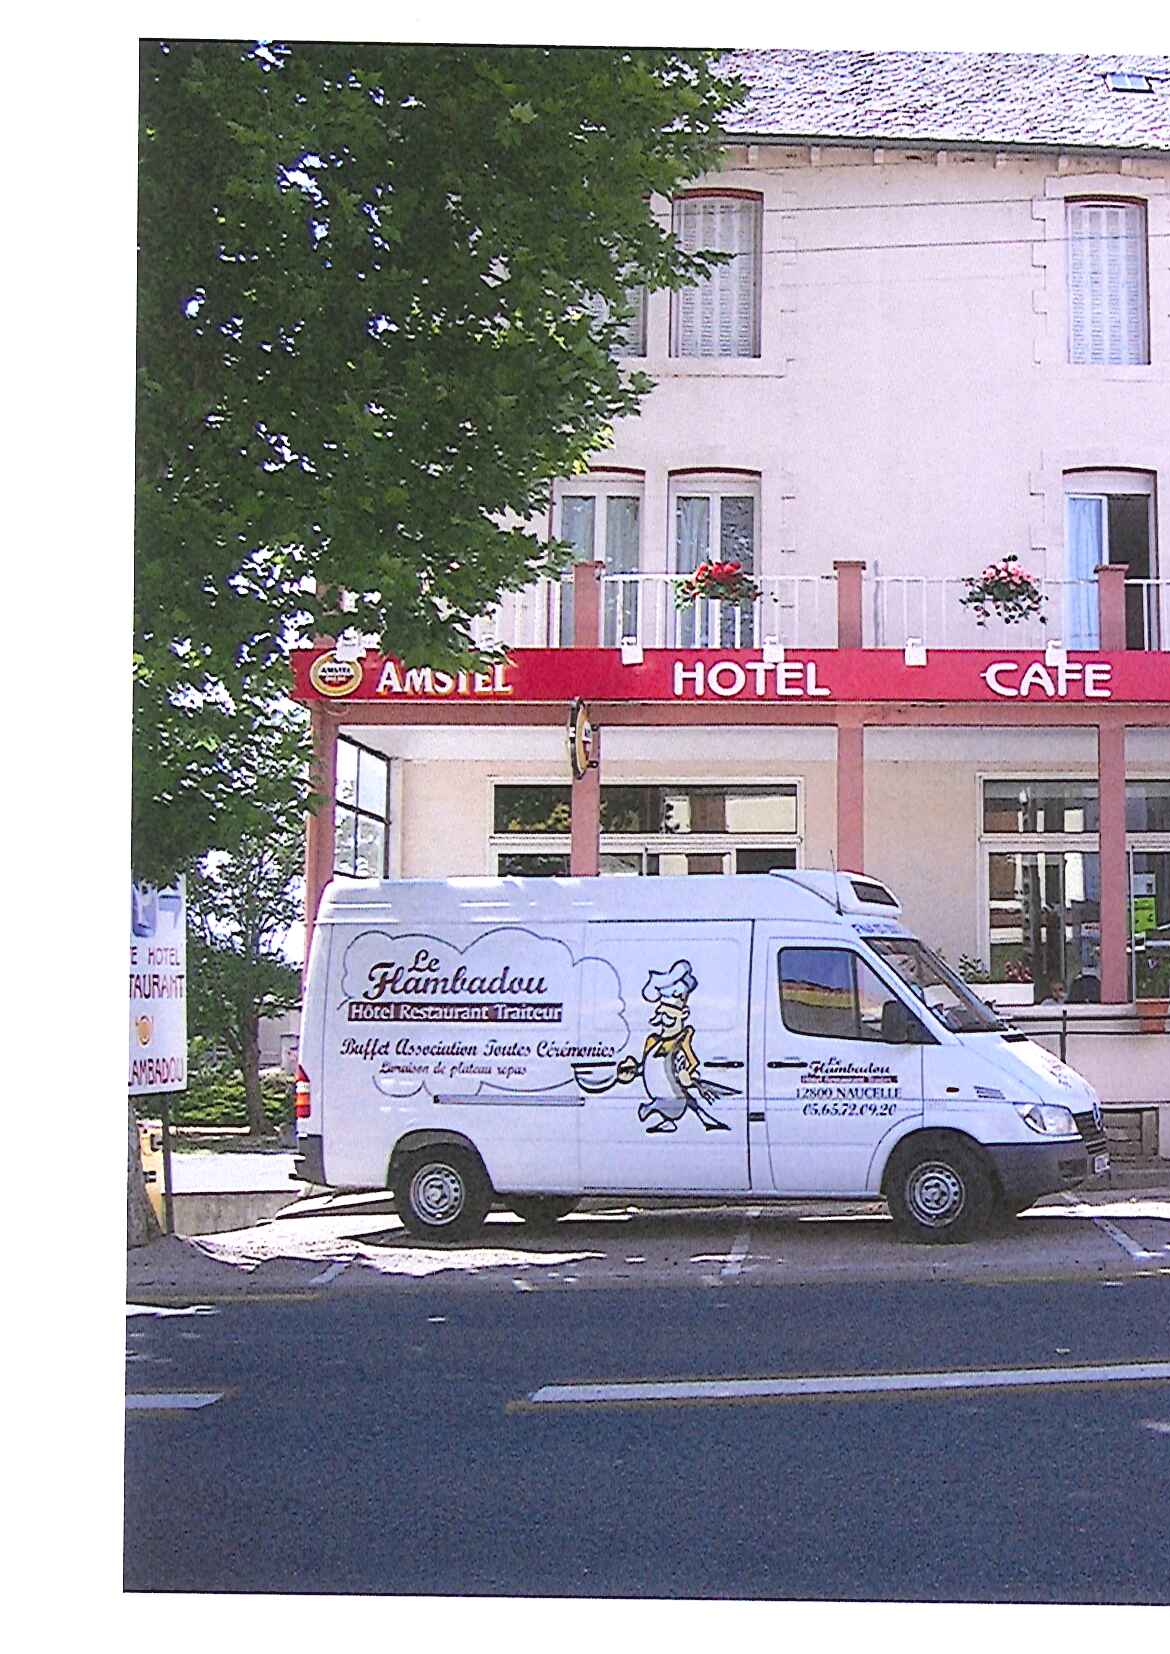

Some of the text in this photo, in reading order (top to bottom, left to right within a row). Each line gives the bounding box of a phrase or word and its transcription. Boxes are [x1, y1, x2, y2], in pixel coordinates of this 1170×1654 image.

[673, 660, 831, 697] HOTEL
[979, 662, 1112, 698] CAFE
[148, 946, 181, 966] HOTEL
[408, 949, 440, 973] Le
[362, 962, 549, 1000] Flambadou
[351, 1003, 562, 1020] Hôtel Restaurant Traiteur
[339, 1038, 615, 1060] Buffet Association Toutes Cérémonies
[433, 1061, 446, 1074] de
[497, 1065, 528, 1079] repas
